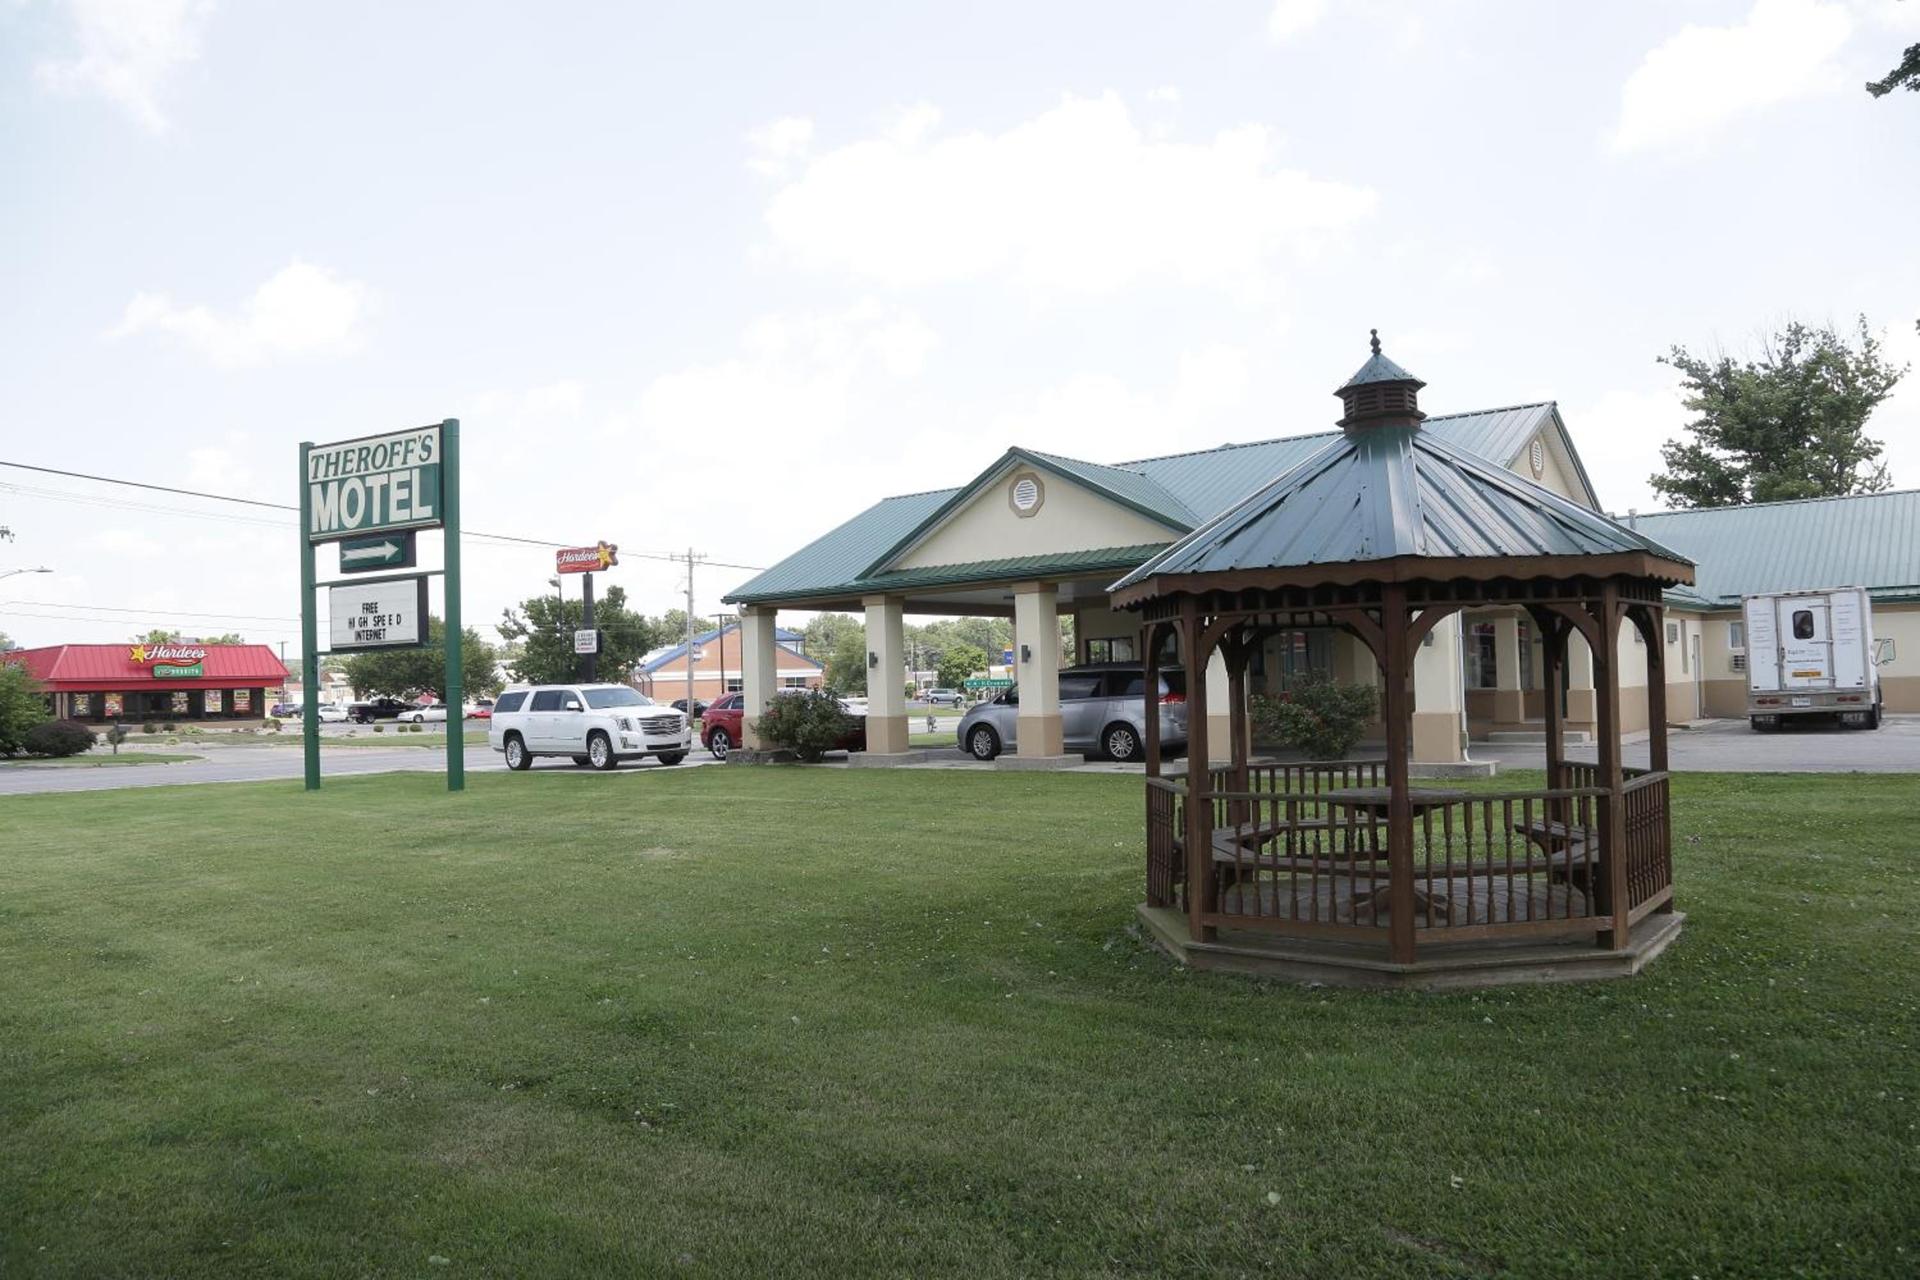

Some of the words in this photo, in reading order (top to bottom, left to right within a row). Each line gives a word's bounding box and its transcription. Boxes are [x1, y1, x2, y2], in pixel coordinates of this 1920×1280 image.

[310, 434, 433, 480] THEROFF'S
[310, 468, 433, 532] MOTEL
[362, 602, 378, 614] FREE
[354, 628, 386, 641] INTERNET
[144, 645, 207, 659] Hardee's
